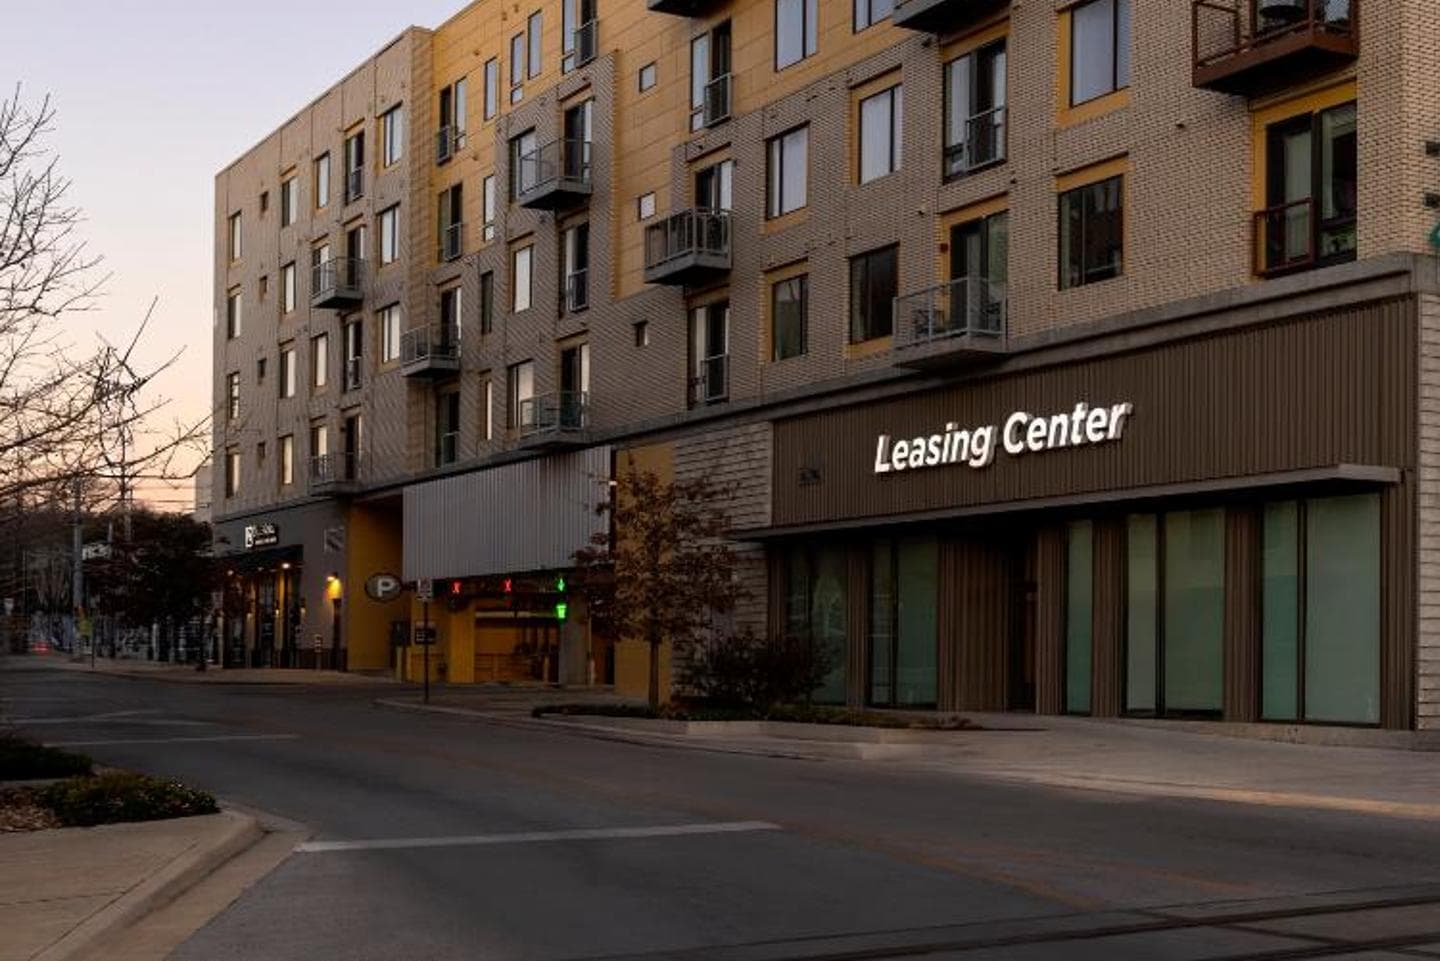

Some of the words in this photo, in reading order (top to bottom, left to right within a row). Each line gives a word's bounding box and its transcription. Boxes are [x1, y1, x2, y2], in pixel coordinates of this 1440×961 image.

[874, 422, 996, 473] Leasing
[1002, 402, 1132, 454] Center
[377, 578, 396, 597] P
